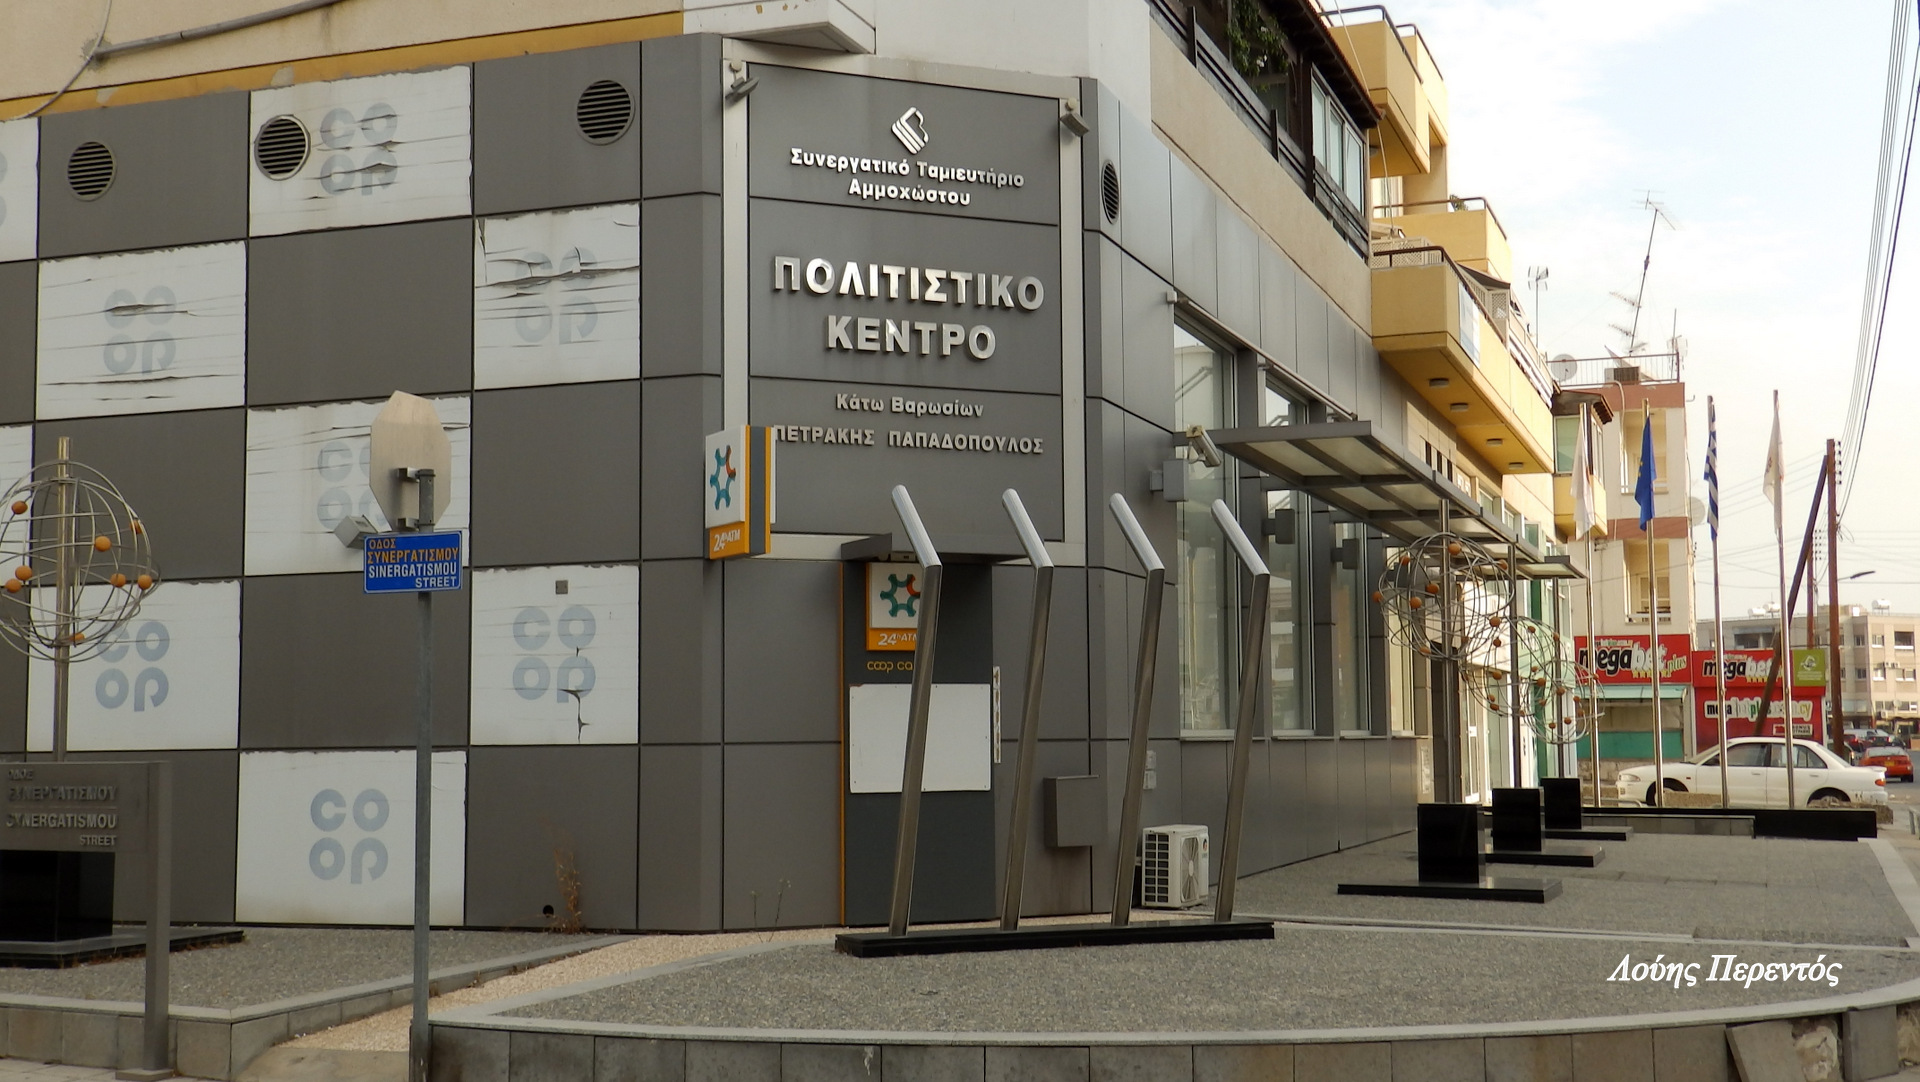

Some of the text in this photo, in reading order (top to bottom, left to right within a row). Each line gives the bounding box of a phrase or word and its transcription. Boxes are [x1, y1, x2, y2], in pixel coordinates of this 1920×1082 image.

[790, 147, 1024, 188] Συνεργατικό Ταμιευτήριο
[848, 178, 971, 207] Αμμοχώστου
[773, 255, 1045, 311] ΠΟΛΙΤΙΣΤΙΚΟ
[826, 315, 997, 360] ΚΕΝΤΡΟ
[836, 393, 984, 418] Κάτω Βαρωσίων
[773, 424, 1044, 454] ΠΕΤΡΑΚΗΣ ΠΑΠΑΔΟΠΟΥΛΟΣ
[369, 538, 396, 549] ΟΔΟΣ
[367, 547, 459, 564] ΣΥΝΕΡΓΑΤΙΣΜΟΥ
[368, 562, 457, 578] SINERGATISMOU
[415, 576, 457, 588] STREET
[897, 661, 913, 670] ca
[6, 813, 117, 829] SYNERGATISMOU
[80, 834, 117, 846] STREET
